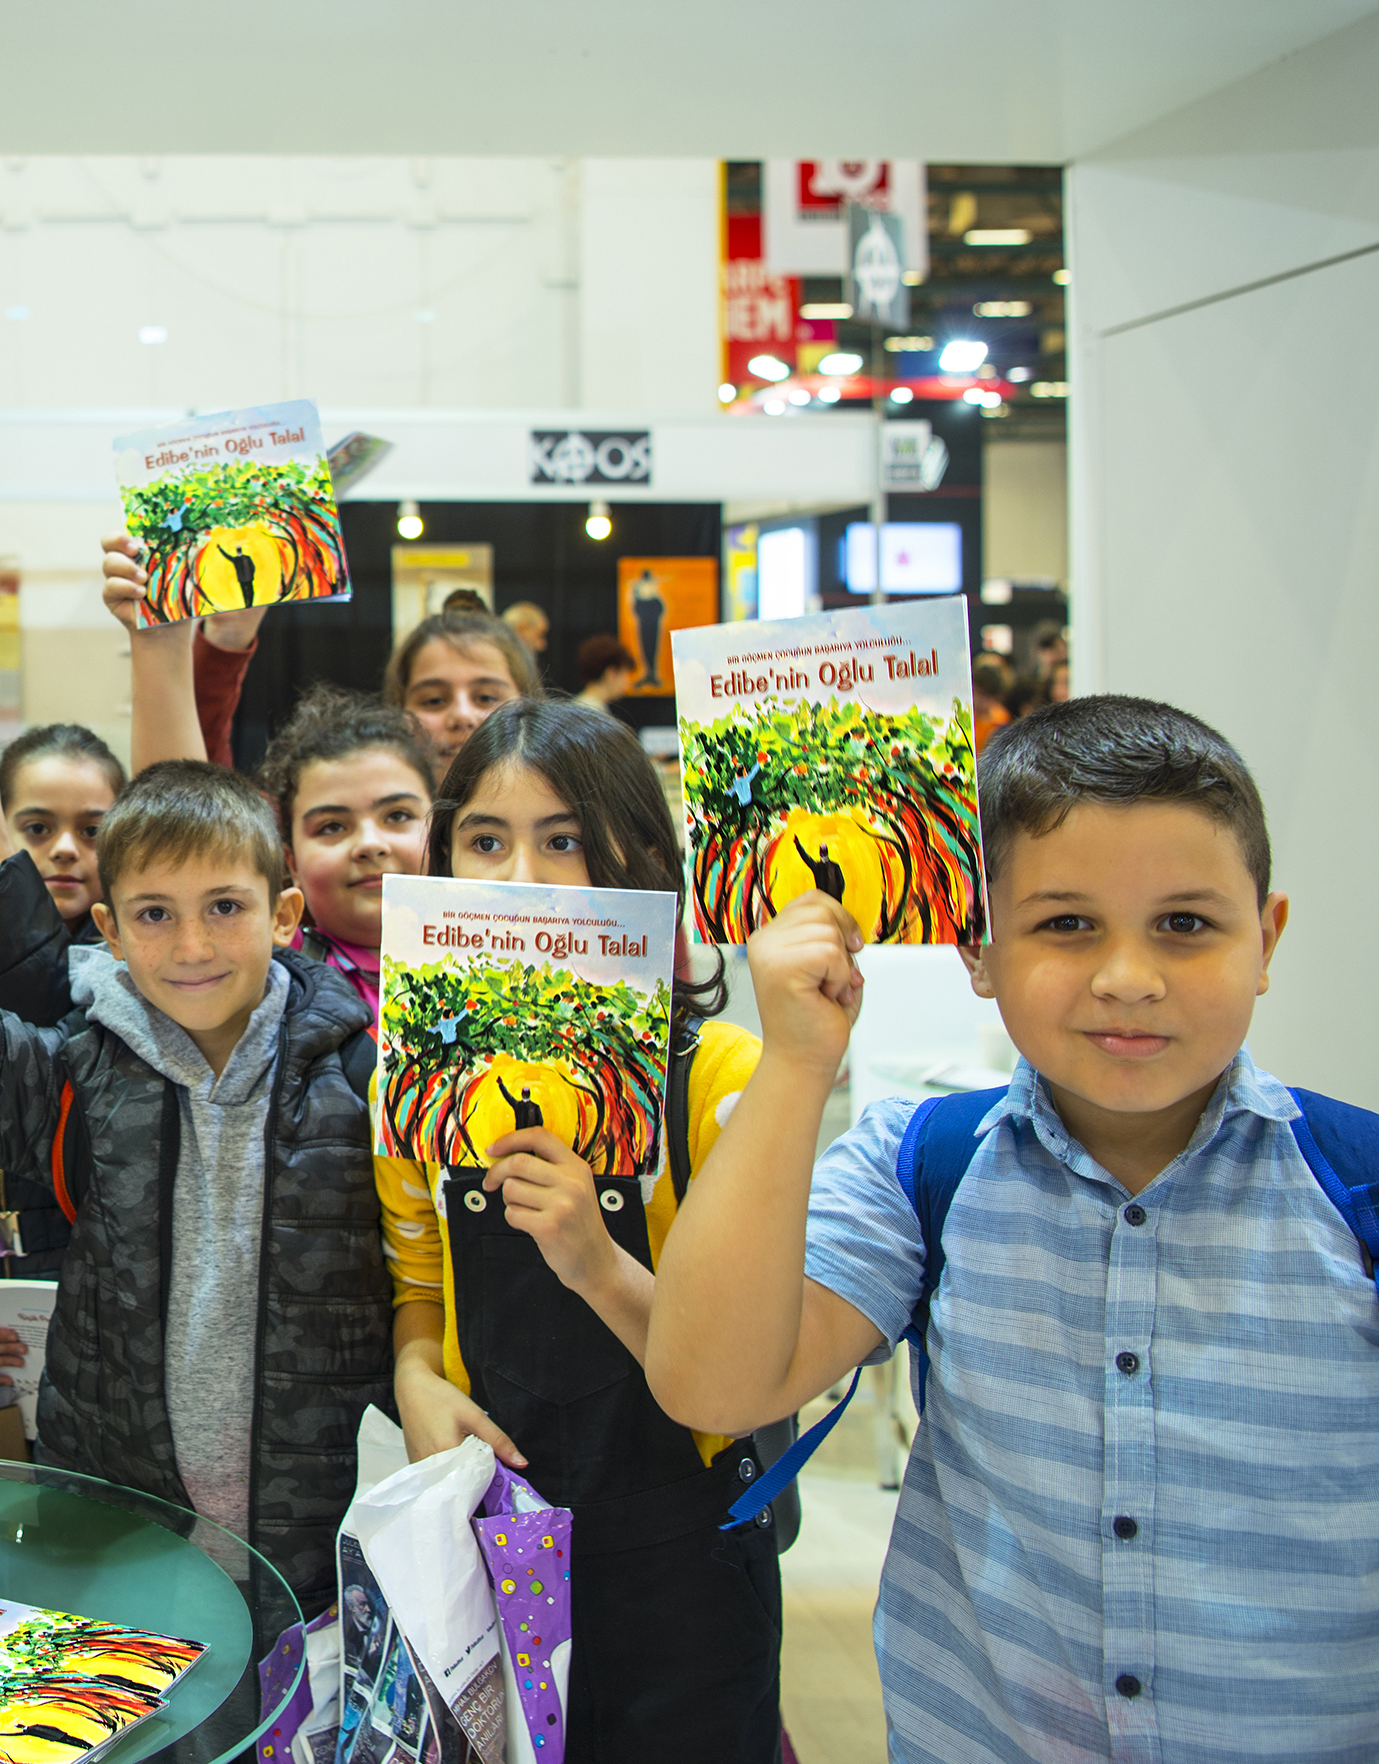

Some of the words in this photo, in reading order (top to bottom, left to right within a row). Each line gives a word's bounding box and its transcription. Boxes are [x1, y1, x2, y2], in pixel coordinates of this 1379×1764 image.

[144, 445, 219, 470] Edibe'nin
[225, 436, 263, 455] Oğlu
[269, 427, 305, 446] Talal
[710, 666, 810, 699] Edibe'nin
[818, 656, 875, 692] Oğlu
[882, 648, 940, 681] Talal
[422, 925, 526, 952] Edibe'nin
[534, 931, 589, 960] Oğlu
[597, 934, 648, 957] Talal
[467, 1662, 498, 1697] BULGAKOV
[460, 1700, 483, 1727] GENÇ
[478, 1684, 496, 1704] BİR
